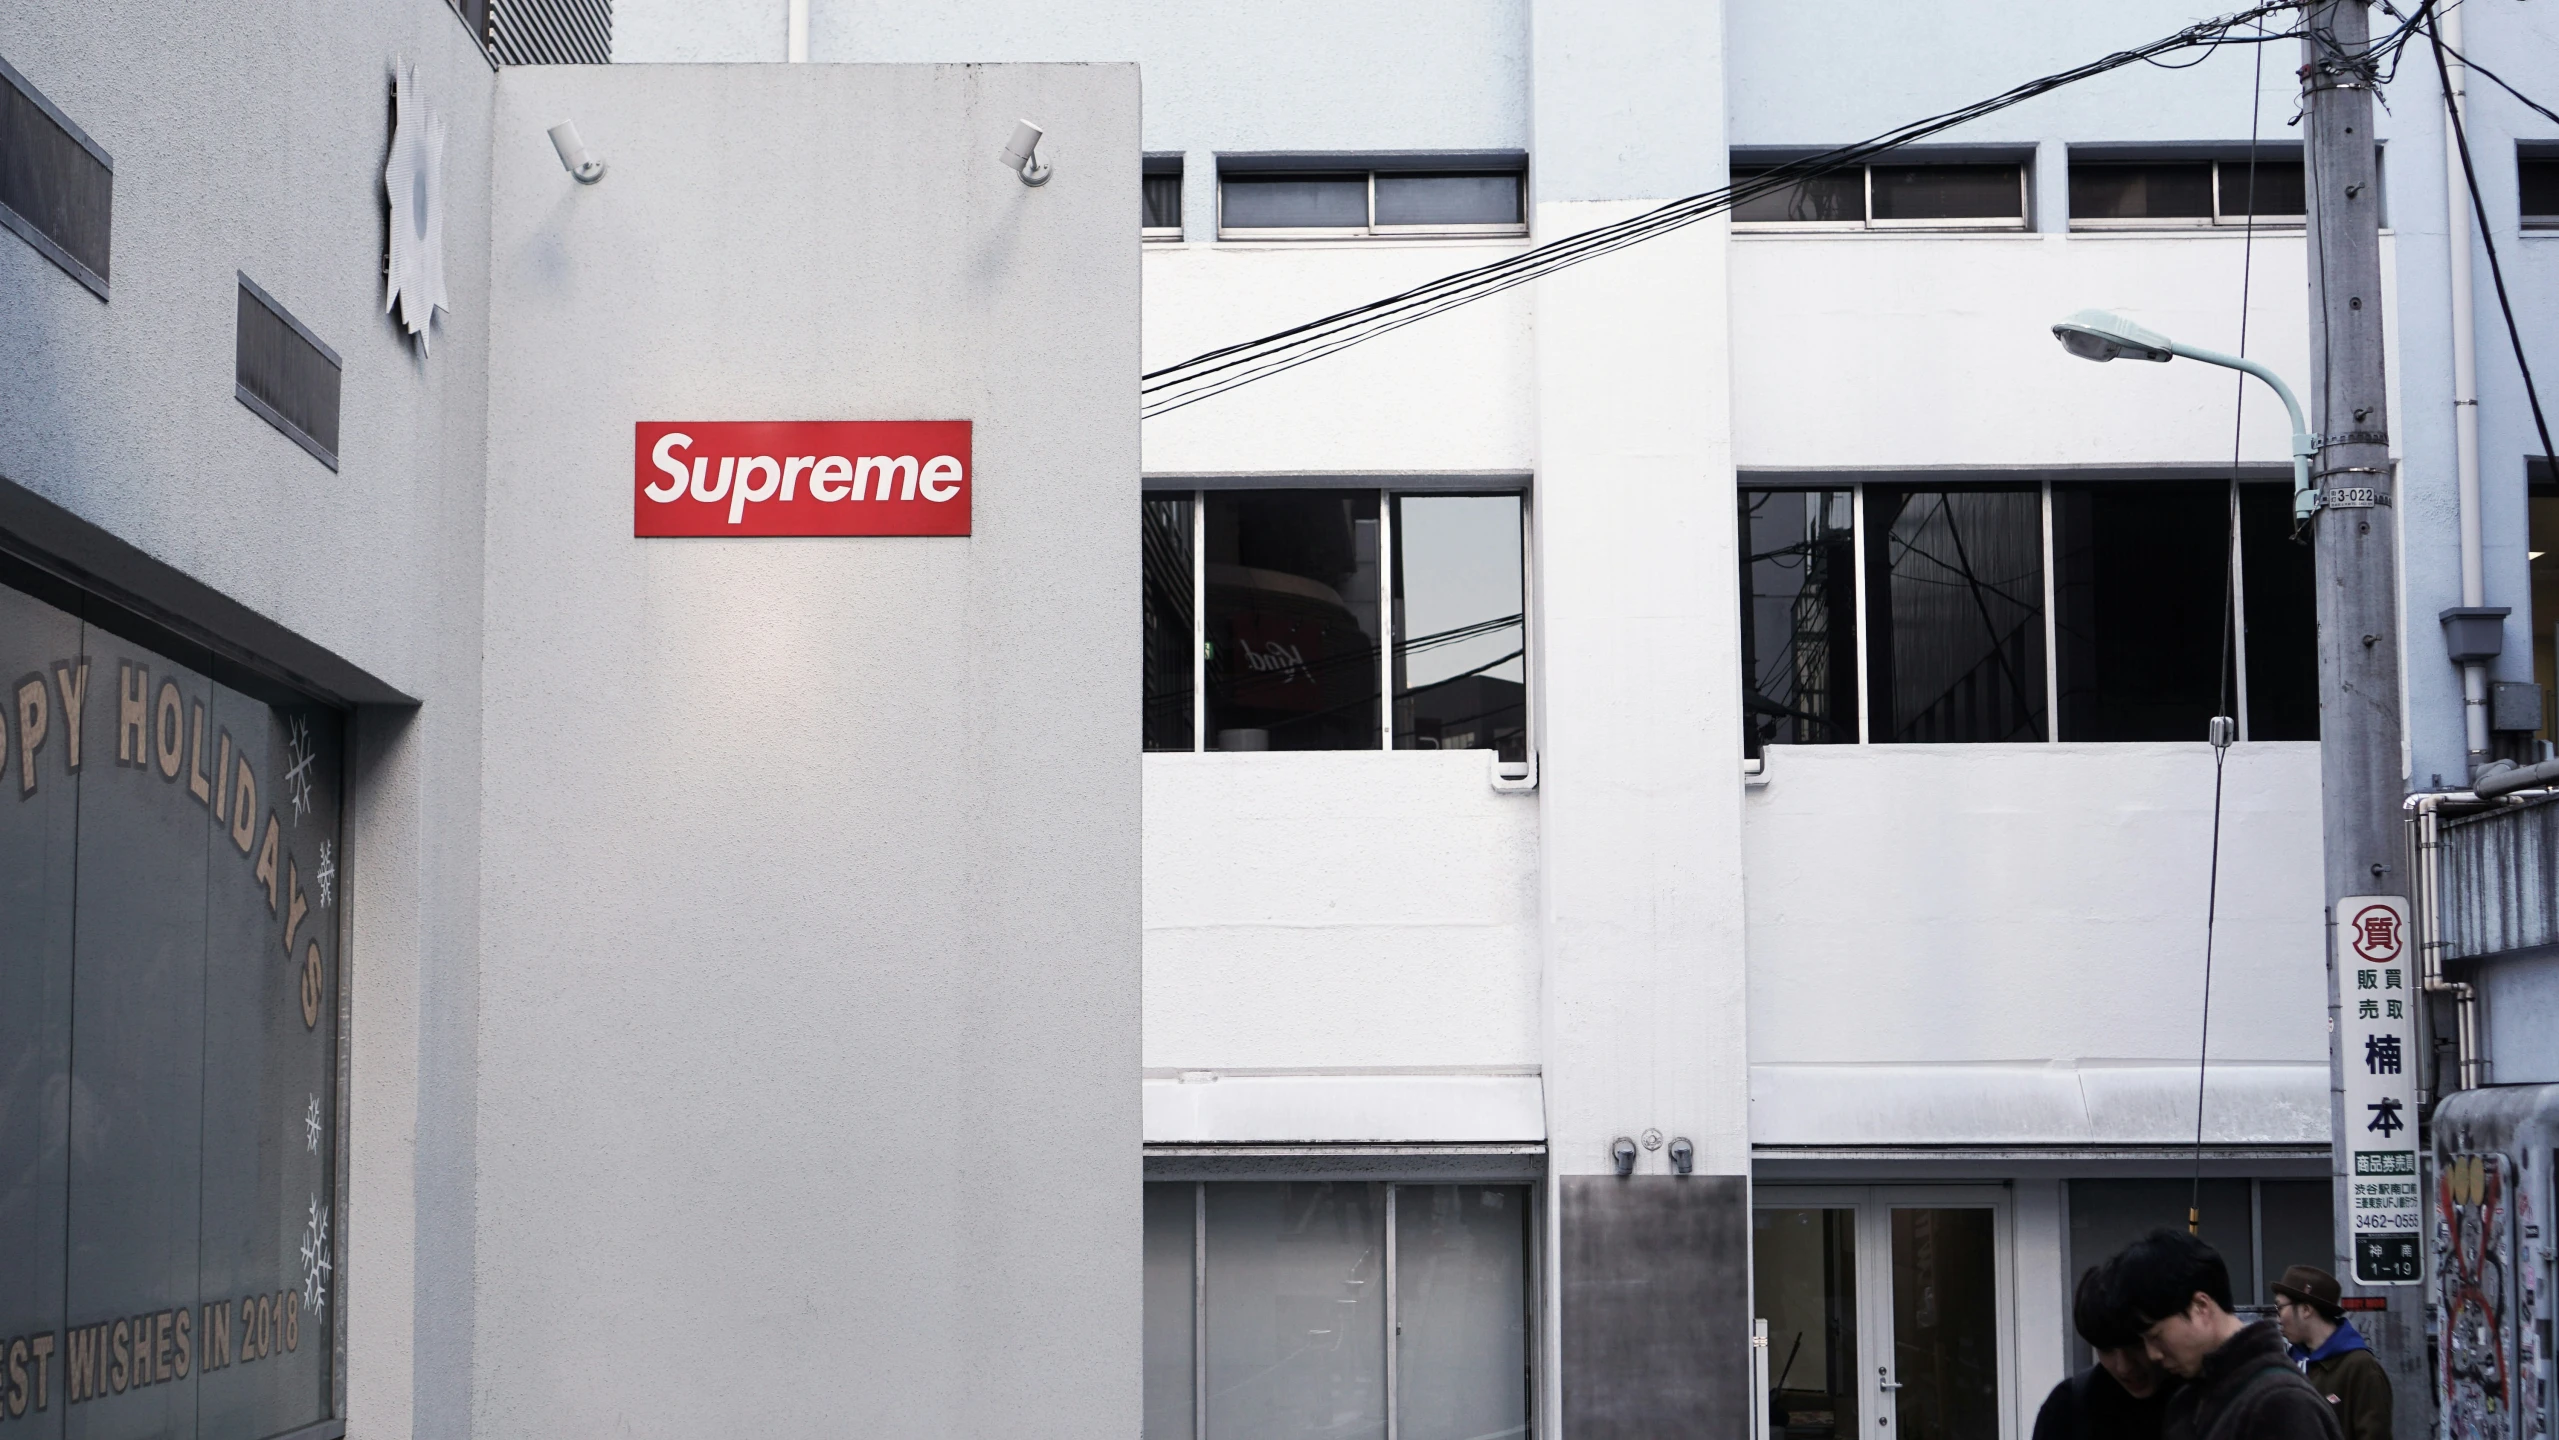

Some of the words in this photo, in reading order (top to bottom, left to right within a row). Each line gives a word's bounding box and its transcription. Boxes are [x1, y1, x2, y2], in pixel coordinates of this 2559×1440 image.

[643, 432, 963, 524] Supreme
[2337, 489, 2373, 502] 3-022
[0, 657, 92, 801] PY
[115, 657, 324, 1033] HOLIDAYS
[2365, 917, 2394, 951] 質
[2356, 1154, 2415, 1173] 商品券売買
[2356, 1214, 2419, 1228] 3462-0555
[2371, 1261, 2411, 1276] 1-19
[65, 1306, 191, 1404] WISHES
[202, 1299, 231, 1373] IN
[240, 1289, 299, 1364] 2018
